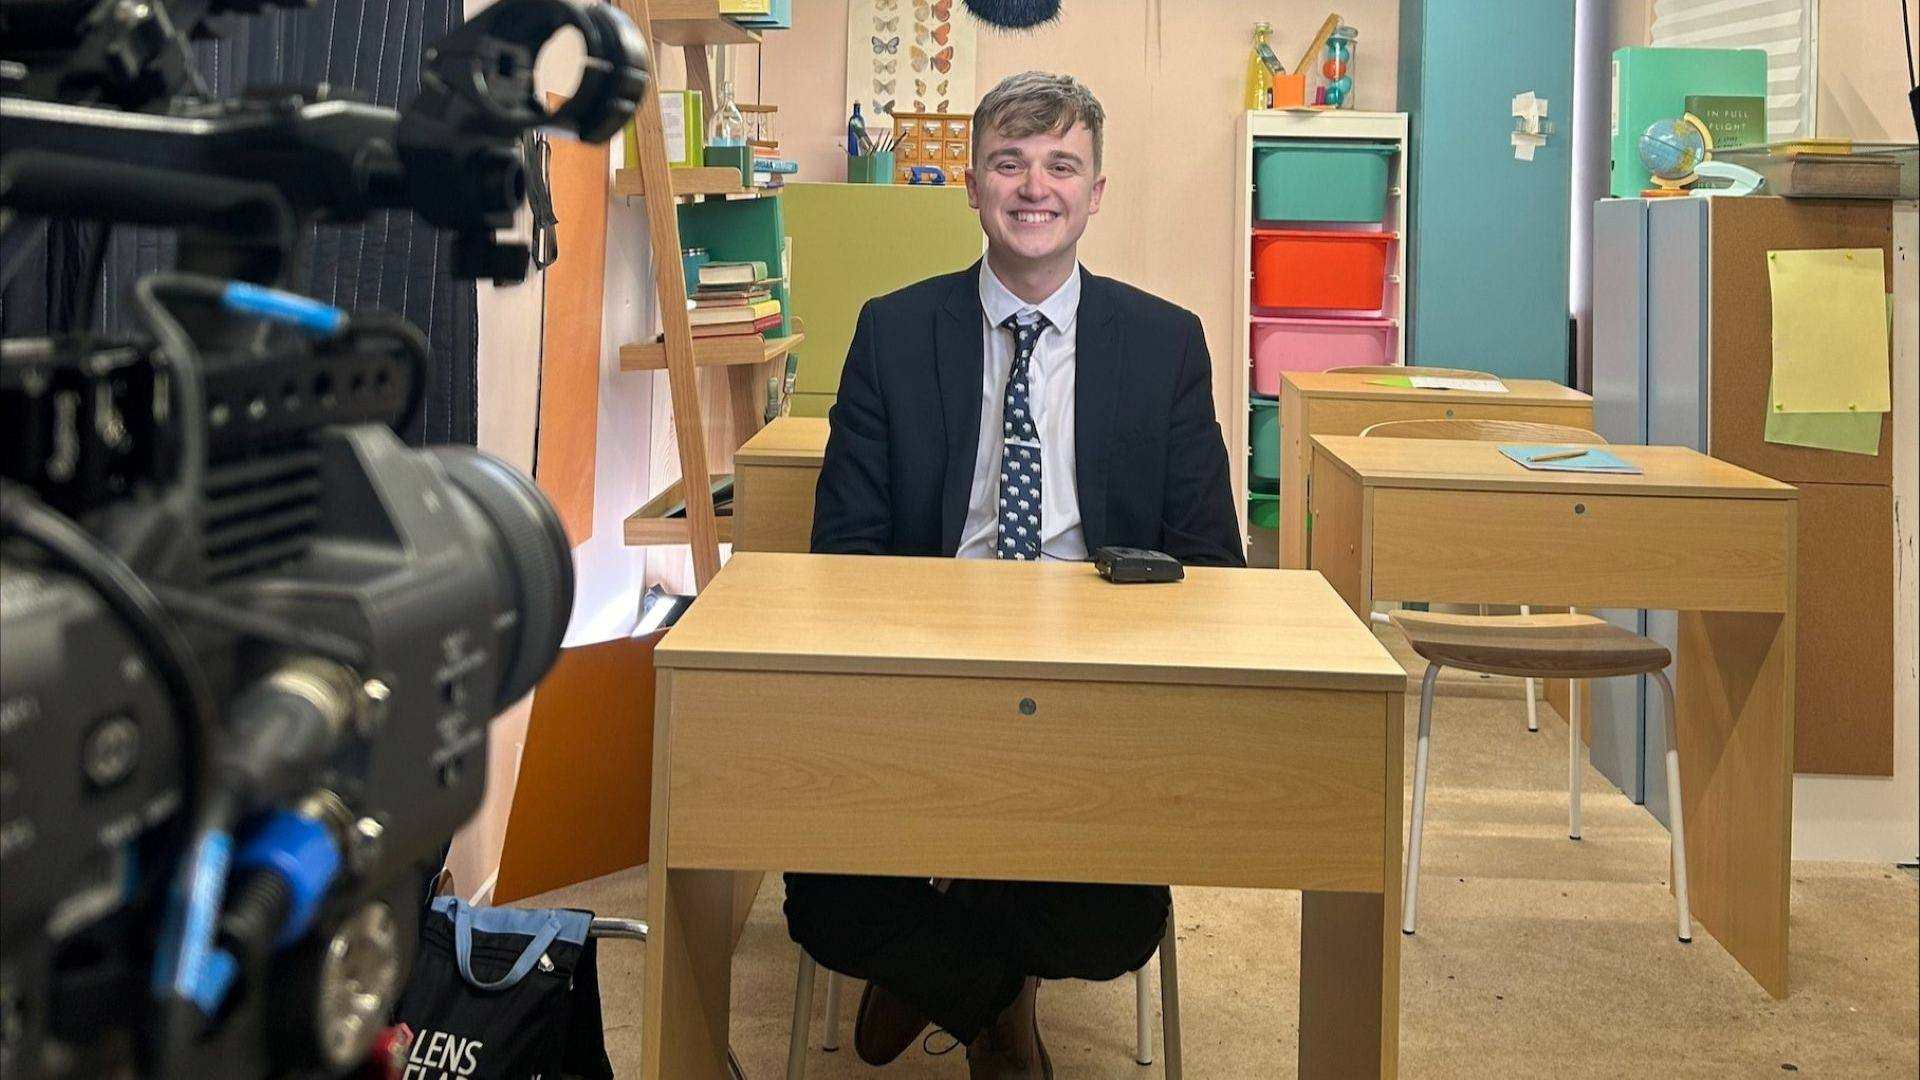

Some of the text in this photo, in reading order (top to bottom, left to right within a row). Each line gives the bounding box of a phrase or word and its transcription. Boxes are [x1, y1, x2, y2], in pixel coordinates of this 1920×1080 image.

[1707, 110, 1751, 119] IN FULL
[1708, 122, 1746, 131] FLIGHT
[410, 1029, 483, 1075] LENS
